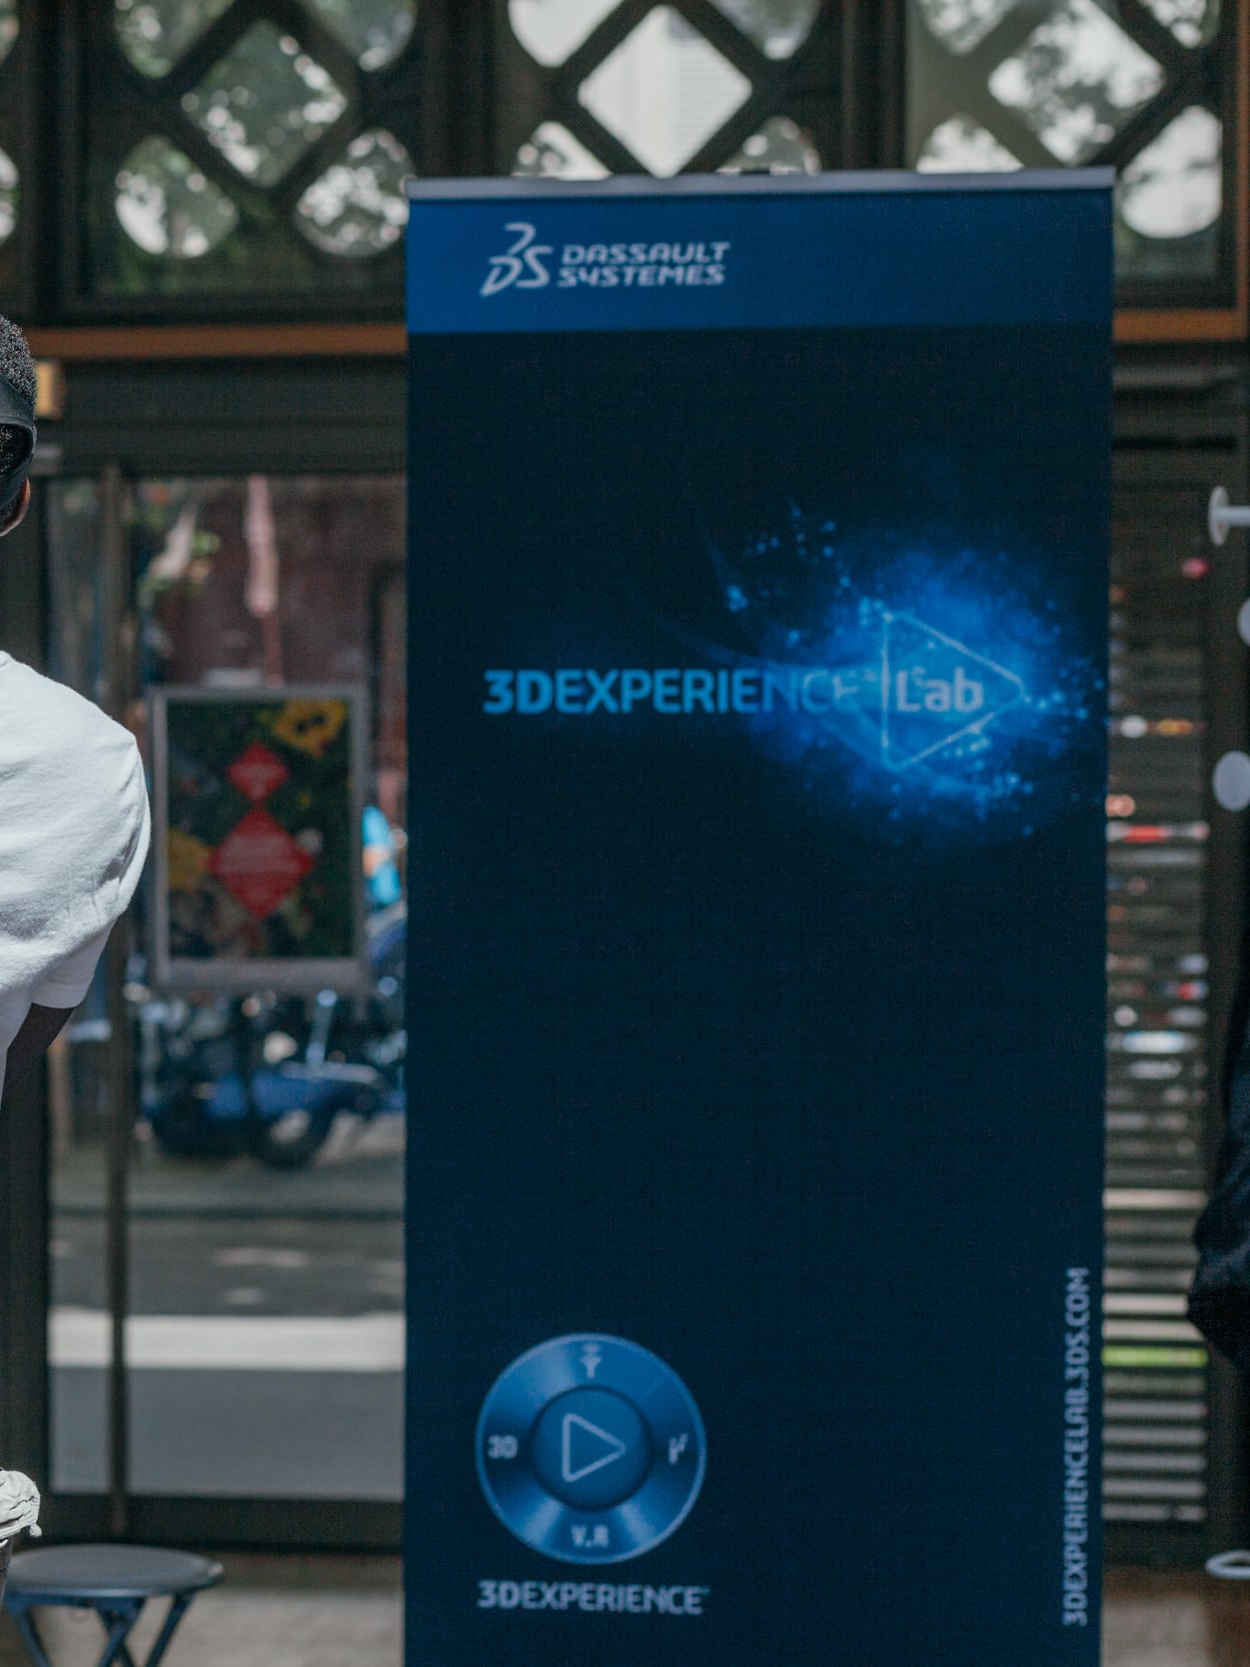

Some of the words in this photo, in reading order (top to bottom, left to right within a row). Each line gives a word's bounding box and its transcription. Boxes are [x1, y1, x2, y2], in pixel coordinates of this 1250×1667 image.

[561, 242, 731, 264] DASSAULT
[557, 265, 726, 287] SYSTEMES
[483, 668, 858, 714] 3DEXPERIENCE
[895, 667, 984, 712] Lab
[1063, 1267, 1090, 1627] 3DEXPERIENCELAB.3DS.COM
[478, 1580, 703, 1615] 3DEXPERIENCE
